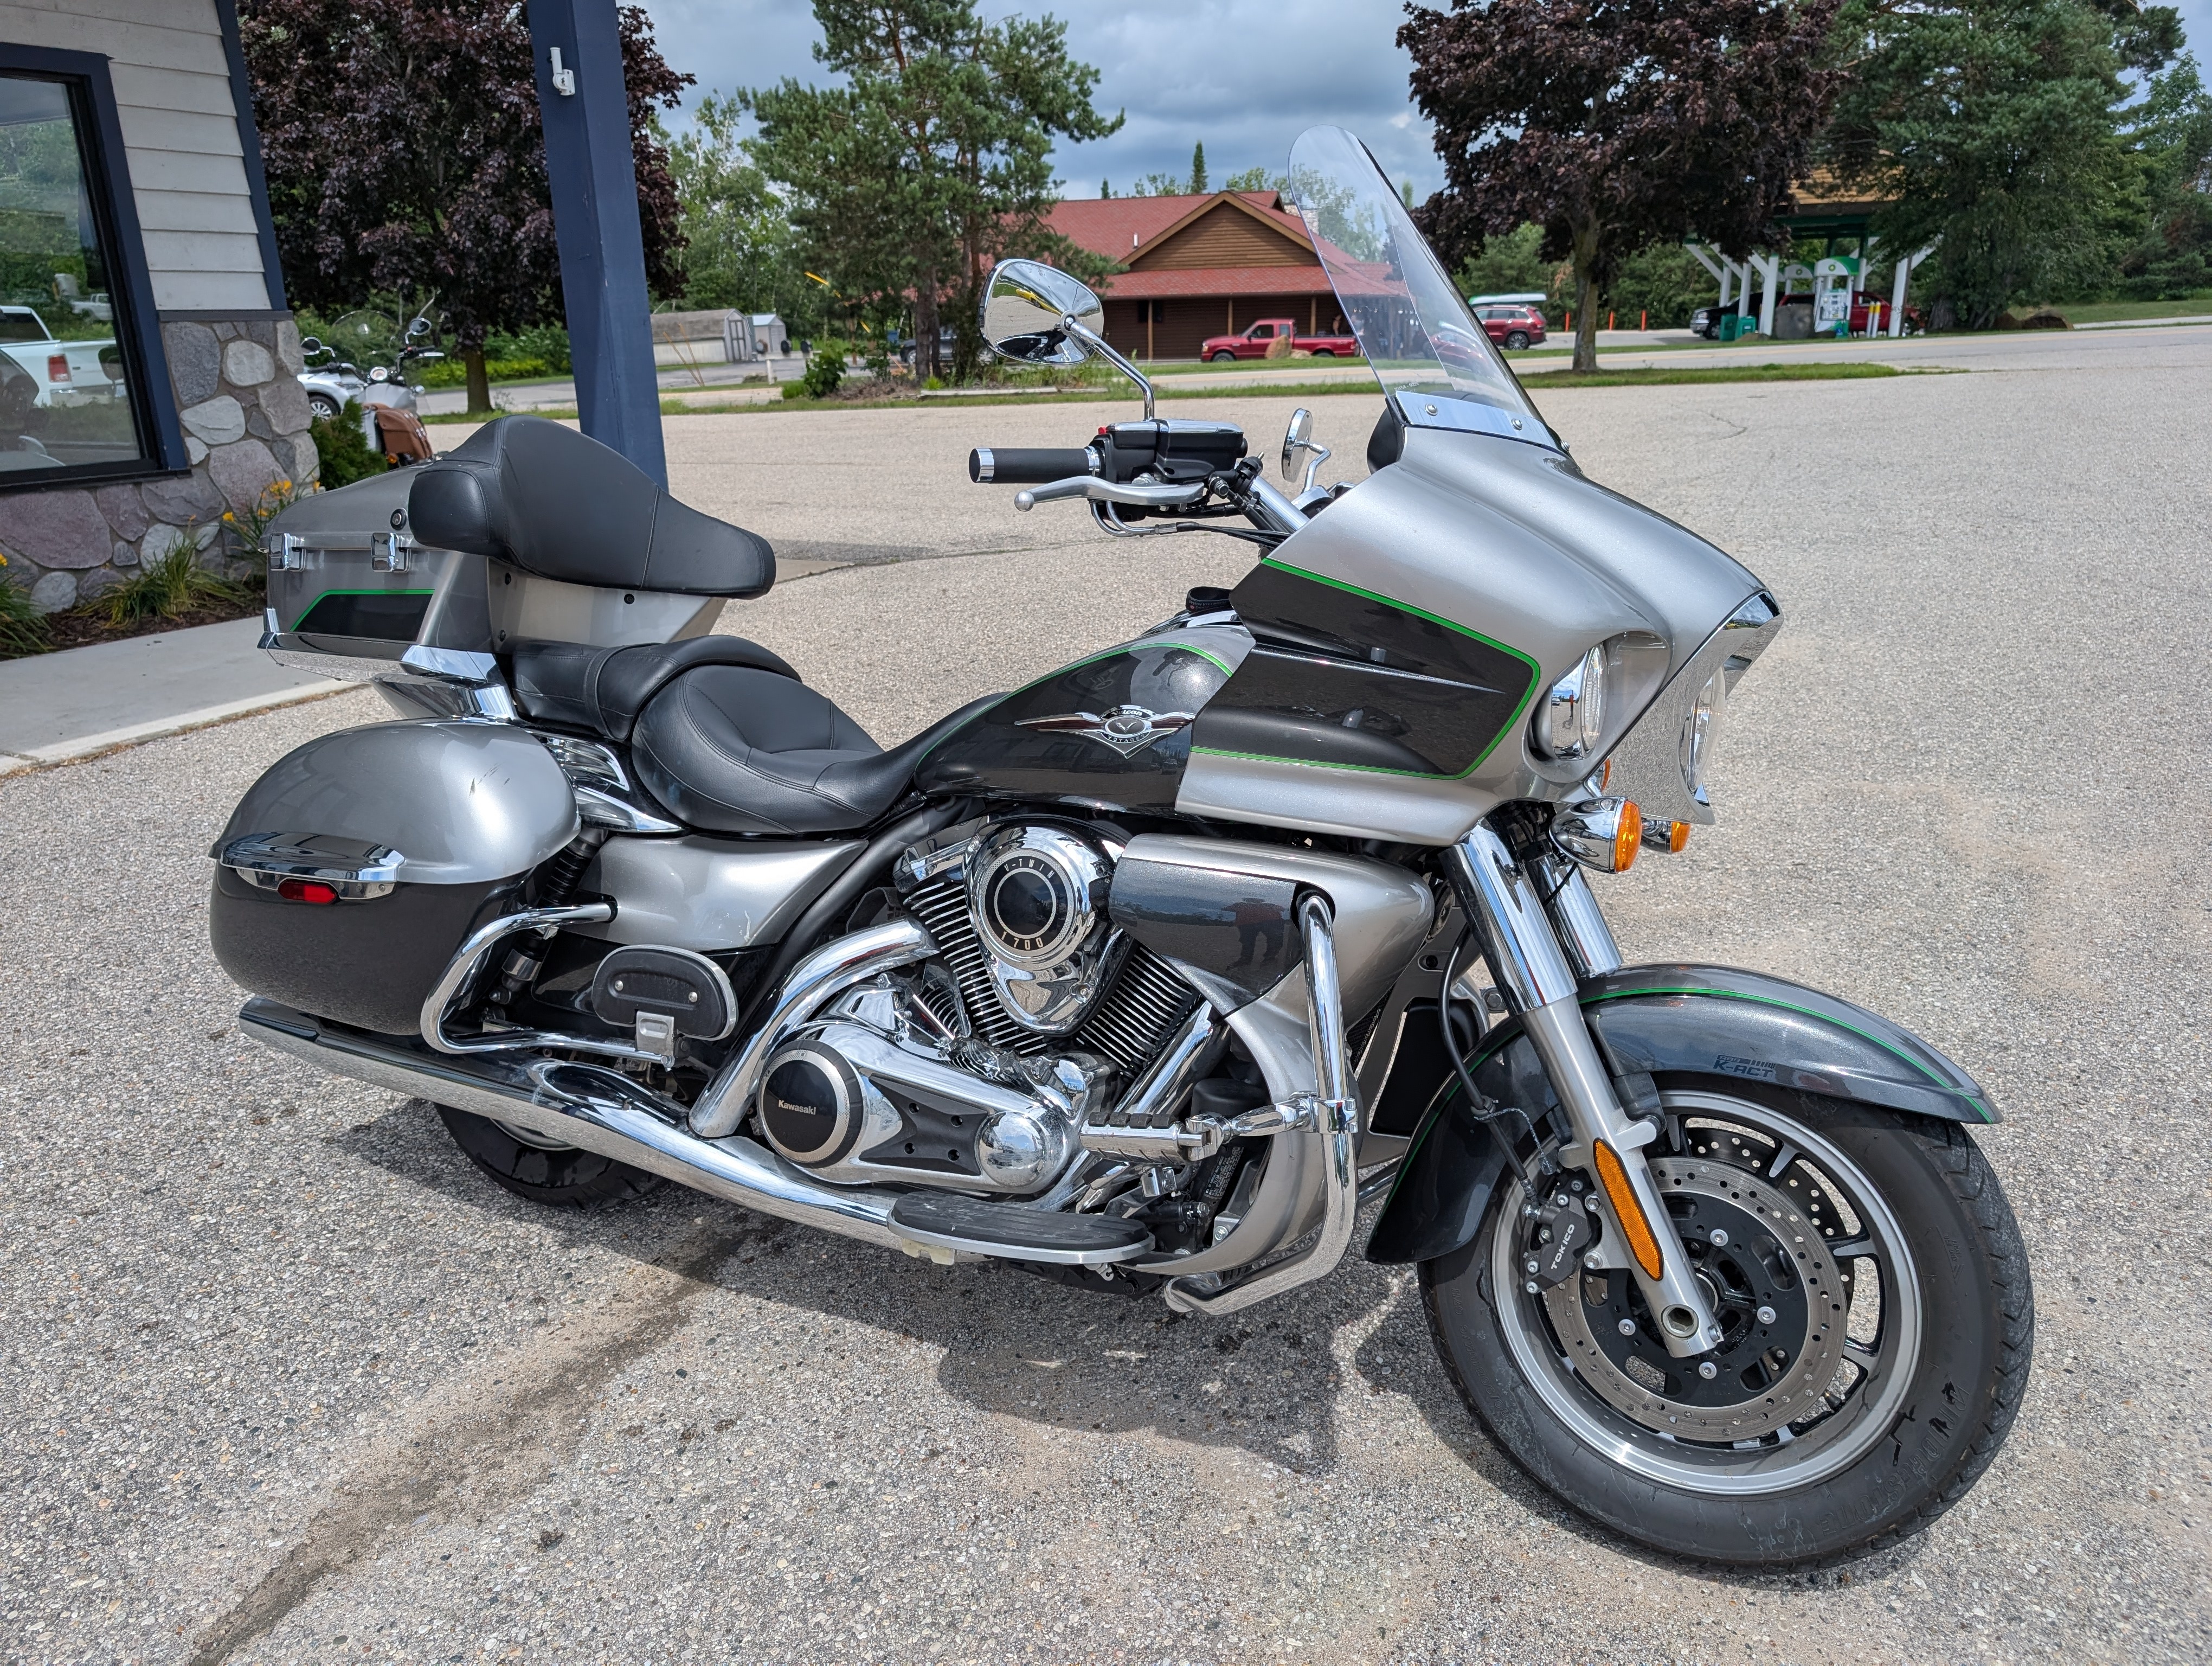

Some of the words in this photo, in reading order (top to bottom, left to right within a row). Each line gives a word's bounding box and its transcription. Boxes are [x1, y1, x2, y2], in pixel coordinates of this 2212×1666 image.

[1108, 734, 1145, 742] VOYAGER
[1004, 858, 1055, 879] V-TWIN
[1001, 931, 1044, 950] 1700
[1713, 1060, 1773, 1078] K-ACT
[779, 1099, 816, 1115] Kawasaki
[1550, 1223, 1575, 1270] TOKICO
